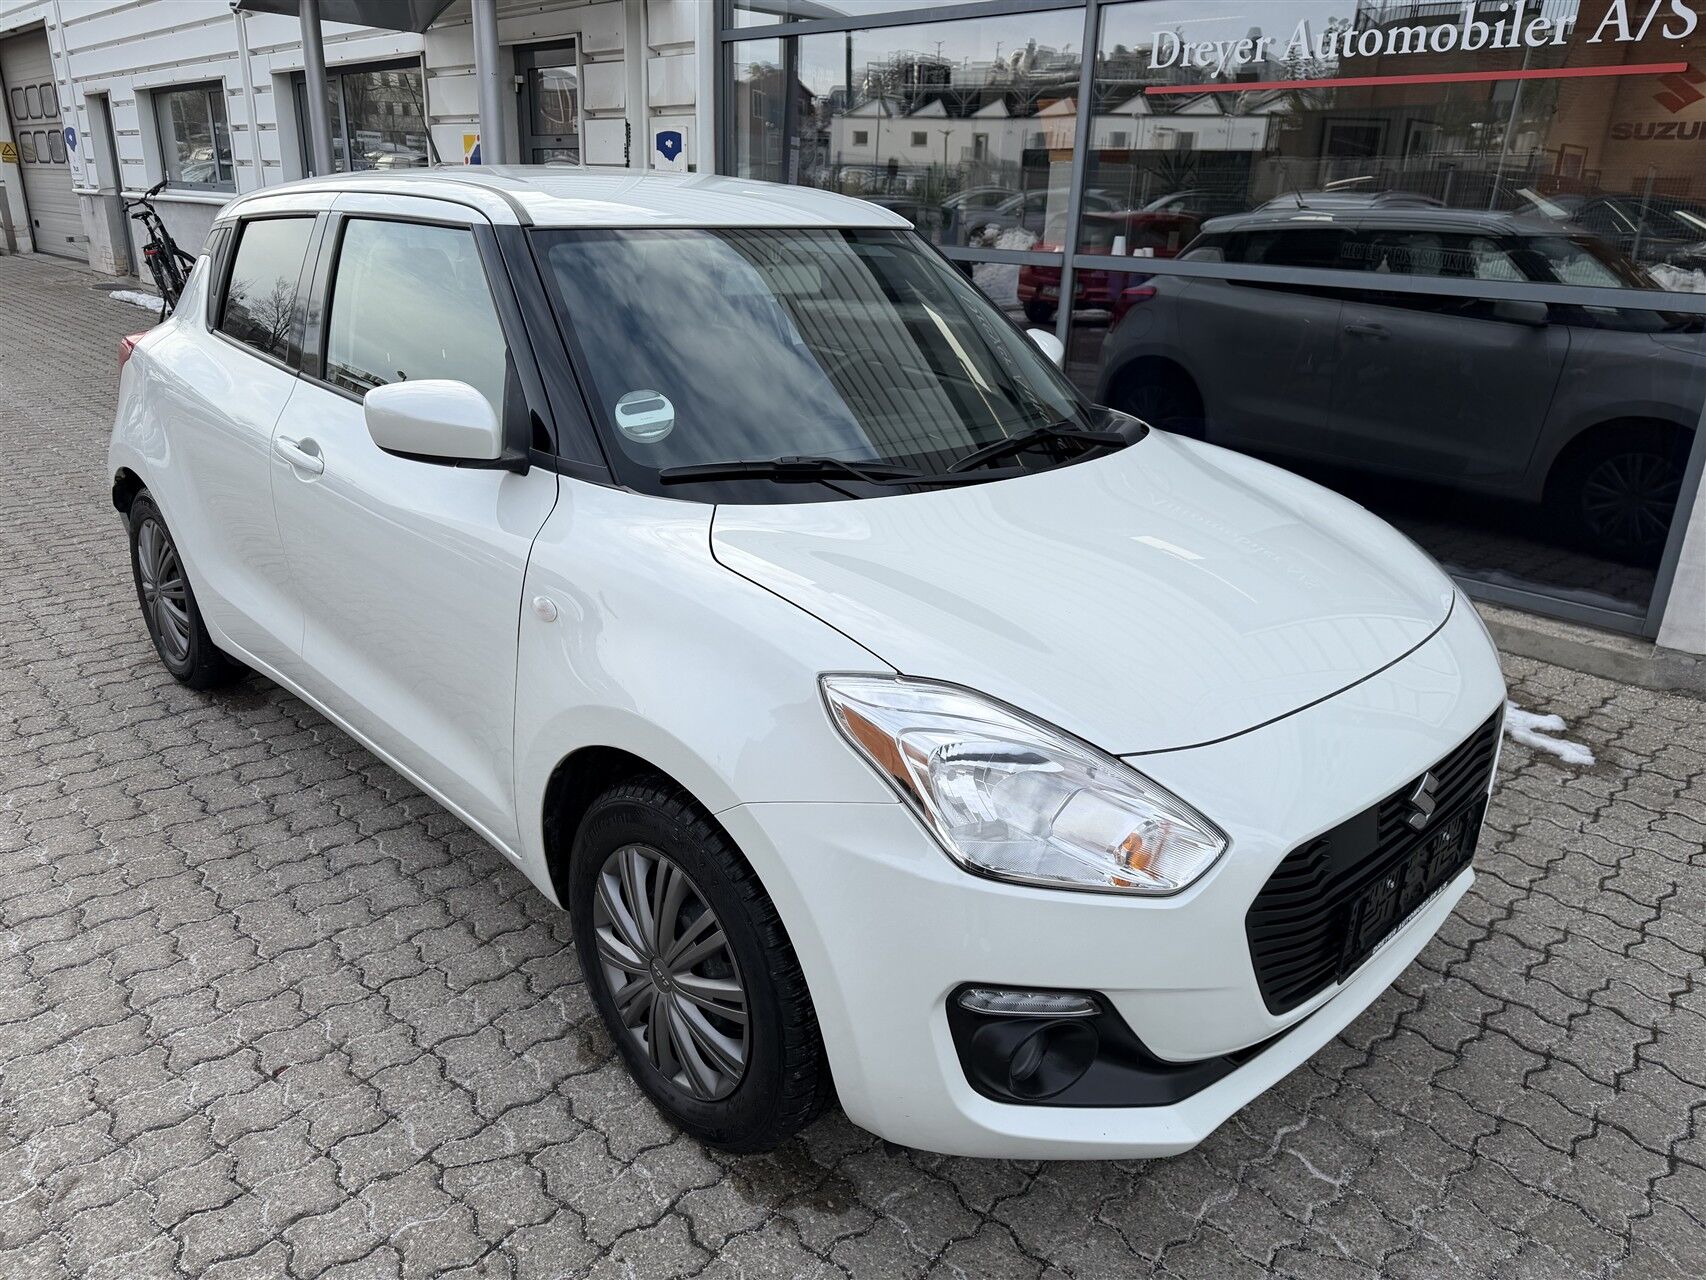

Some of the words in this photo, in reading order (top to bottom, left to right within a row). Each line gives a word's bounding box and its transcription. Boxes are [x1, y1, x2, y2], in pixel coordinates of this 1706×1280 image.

[1147, 30, 1272, 79] Dreyer
[1279, 0, 1578, 61] Automobiler
[1586, 0, 1699, 44] A/S
